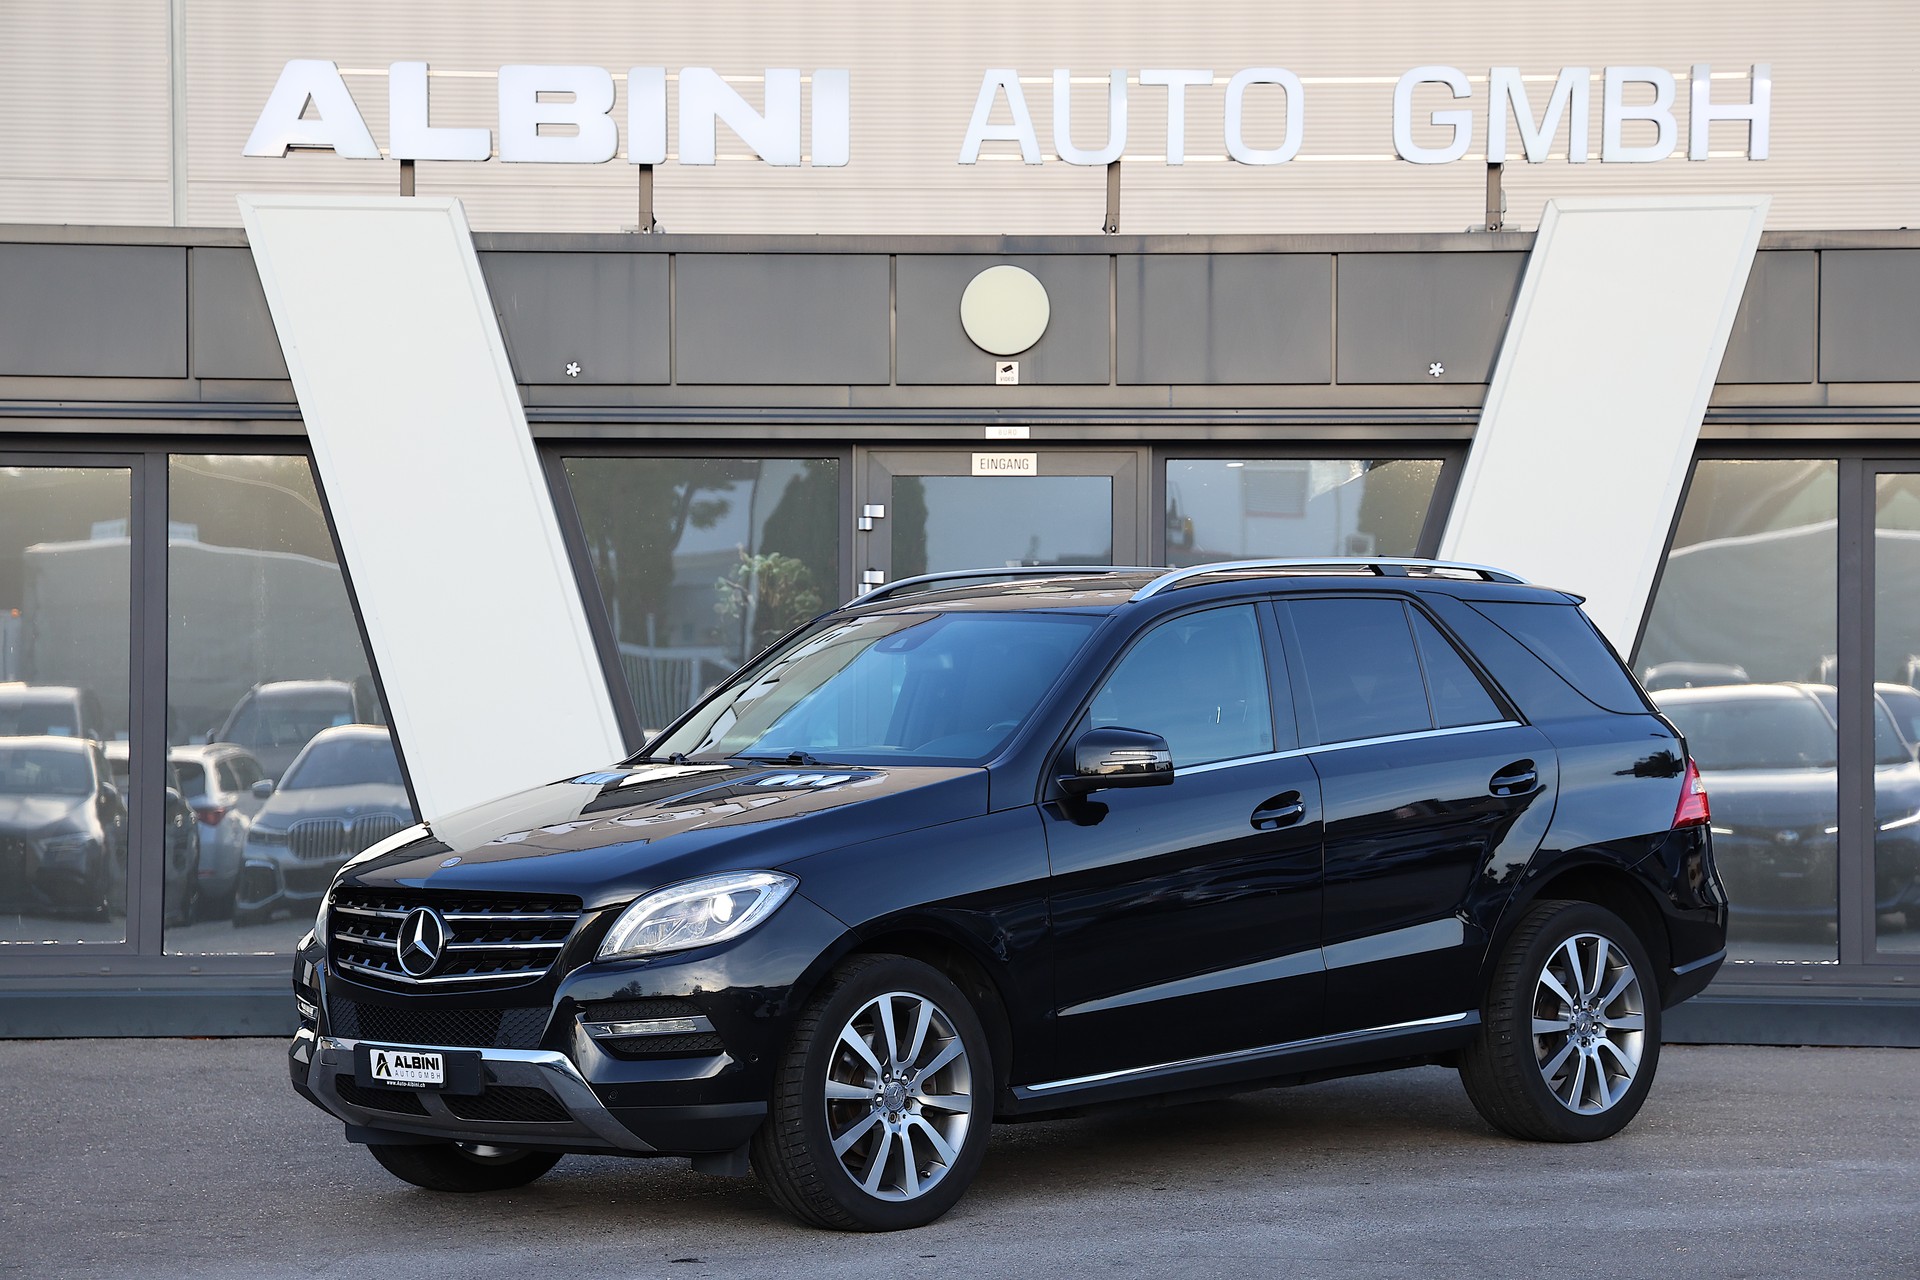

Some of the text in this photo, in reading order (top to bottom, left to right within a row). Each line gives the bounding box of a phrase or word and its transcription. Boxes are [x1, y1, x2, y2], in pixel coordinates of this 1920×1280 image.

[241, 59, 1772, 167] ALBINI AUTO GMBH
[980, 458, 1029, 470] EINGANG
[394, 1055, 440, 1071] ALBINI
[394, 1070, 415, 1078] AUTO
